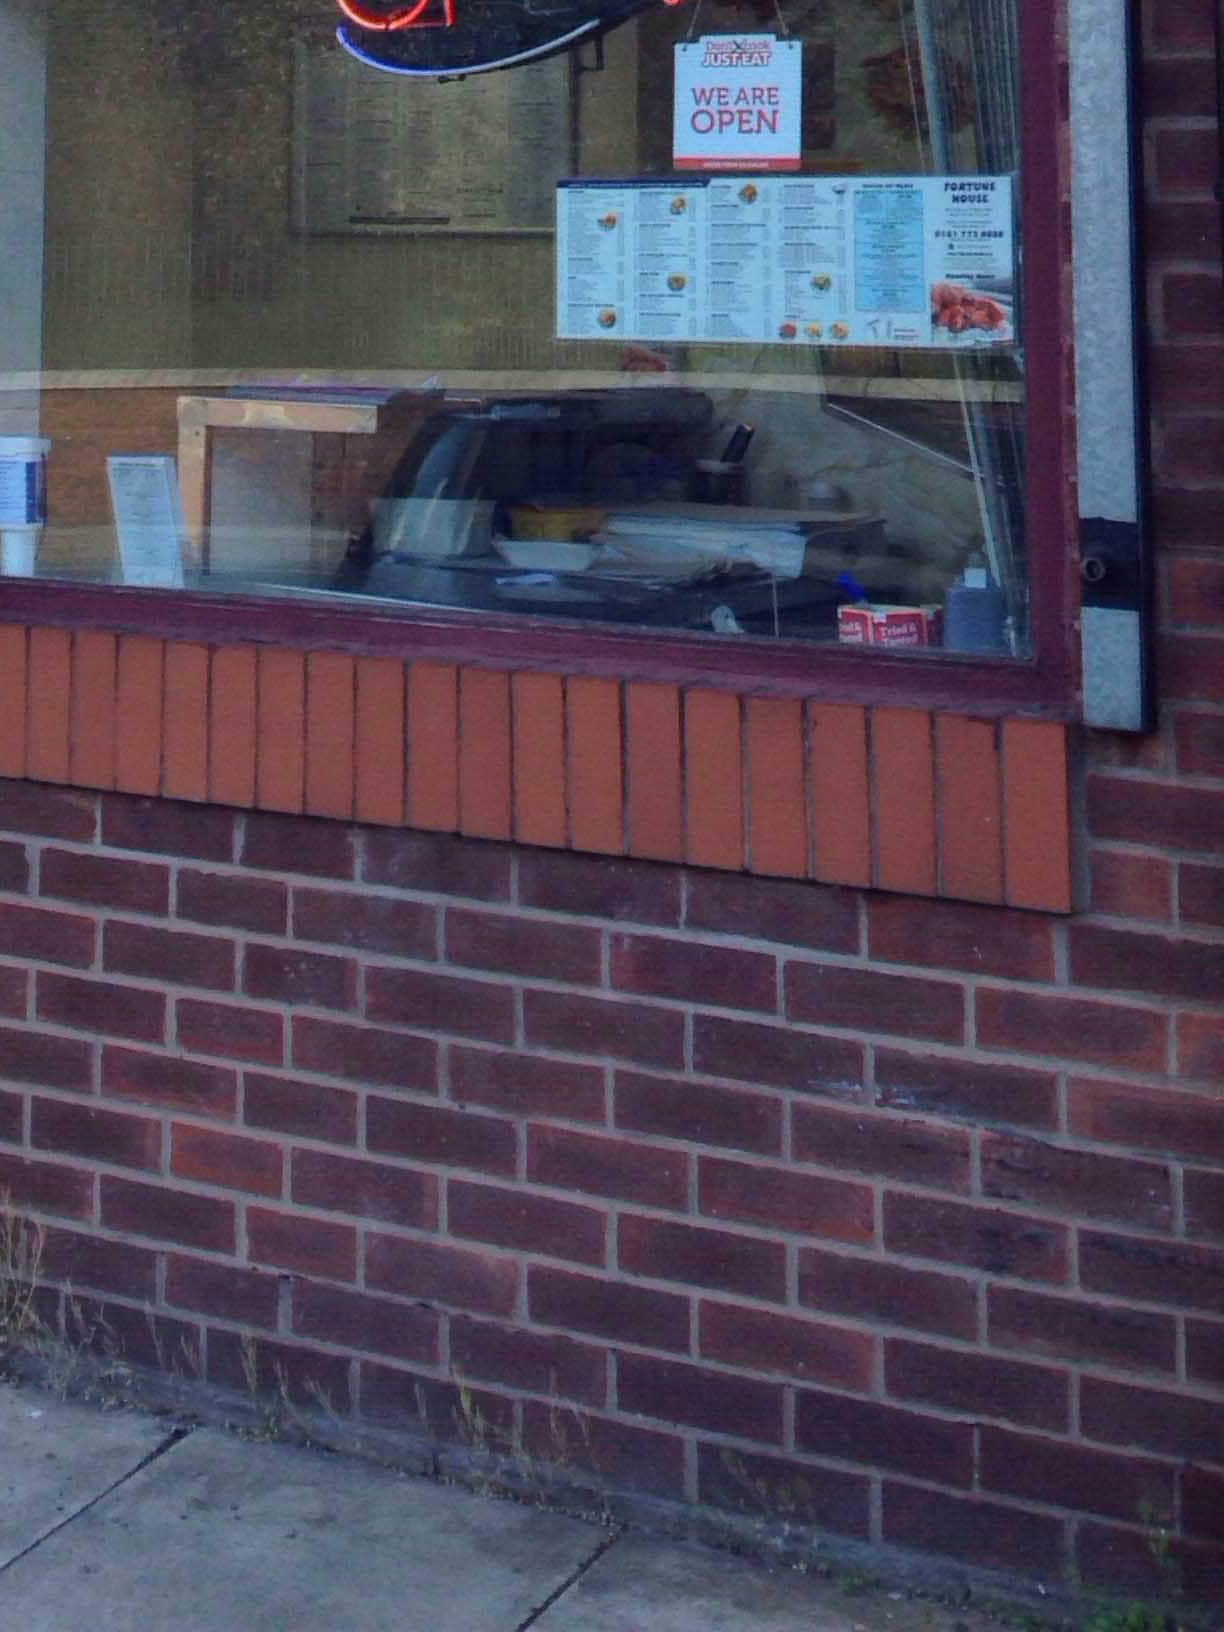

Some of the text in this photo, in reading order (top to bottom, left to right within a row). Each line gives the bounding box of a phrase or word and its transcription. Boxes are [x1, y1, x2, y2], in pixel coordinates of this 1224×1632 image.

[703, 51, 773, 68] JUST EAT
[691, 86, 781, 106] WE ARE
[691, 108, 780, 135] OPEN
[944, 181, 996, 192] FORTUNE
[952, 194, 989, 204] HOUSE
